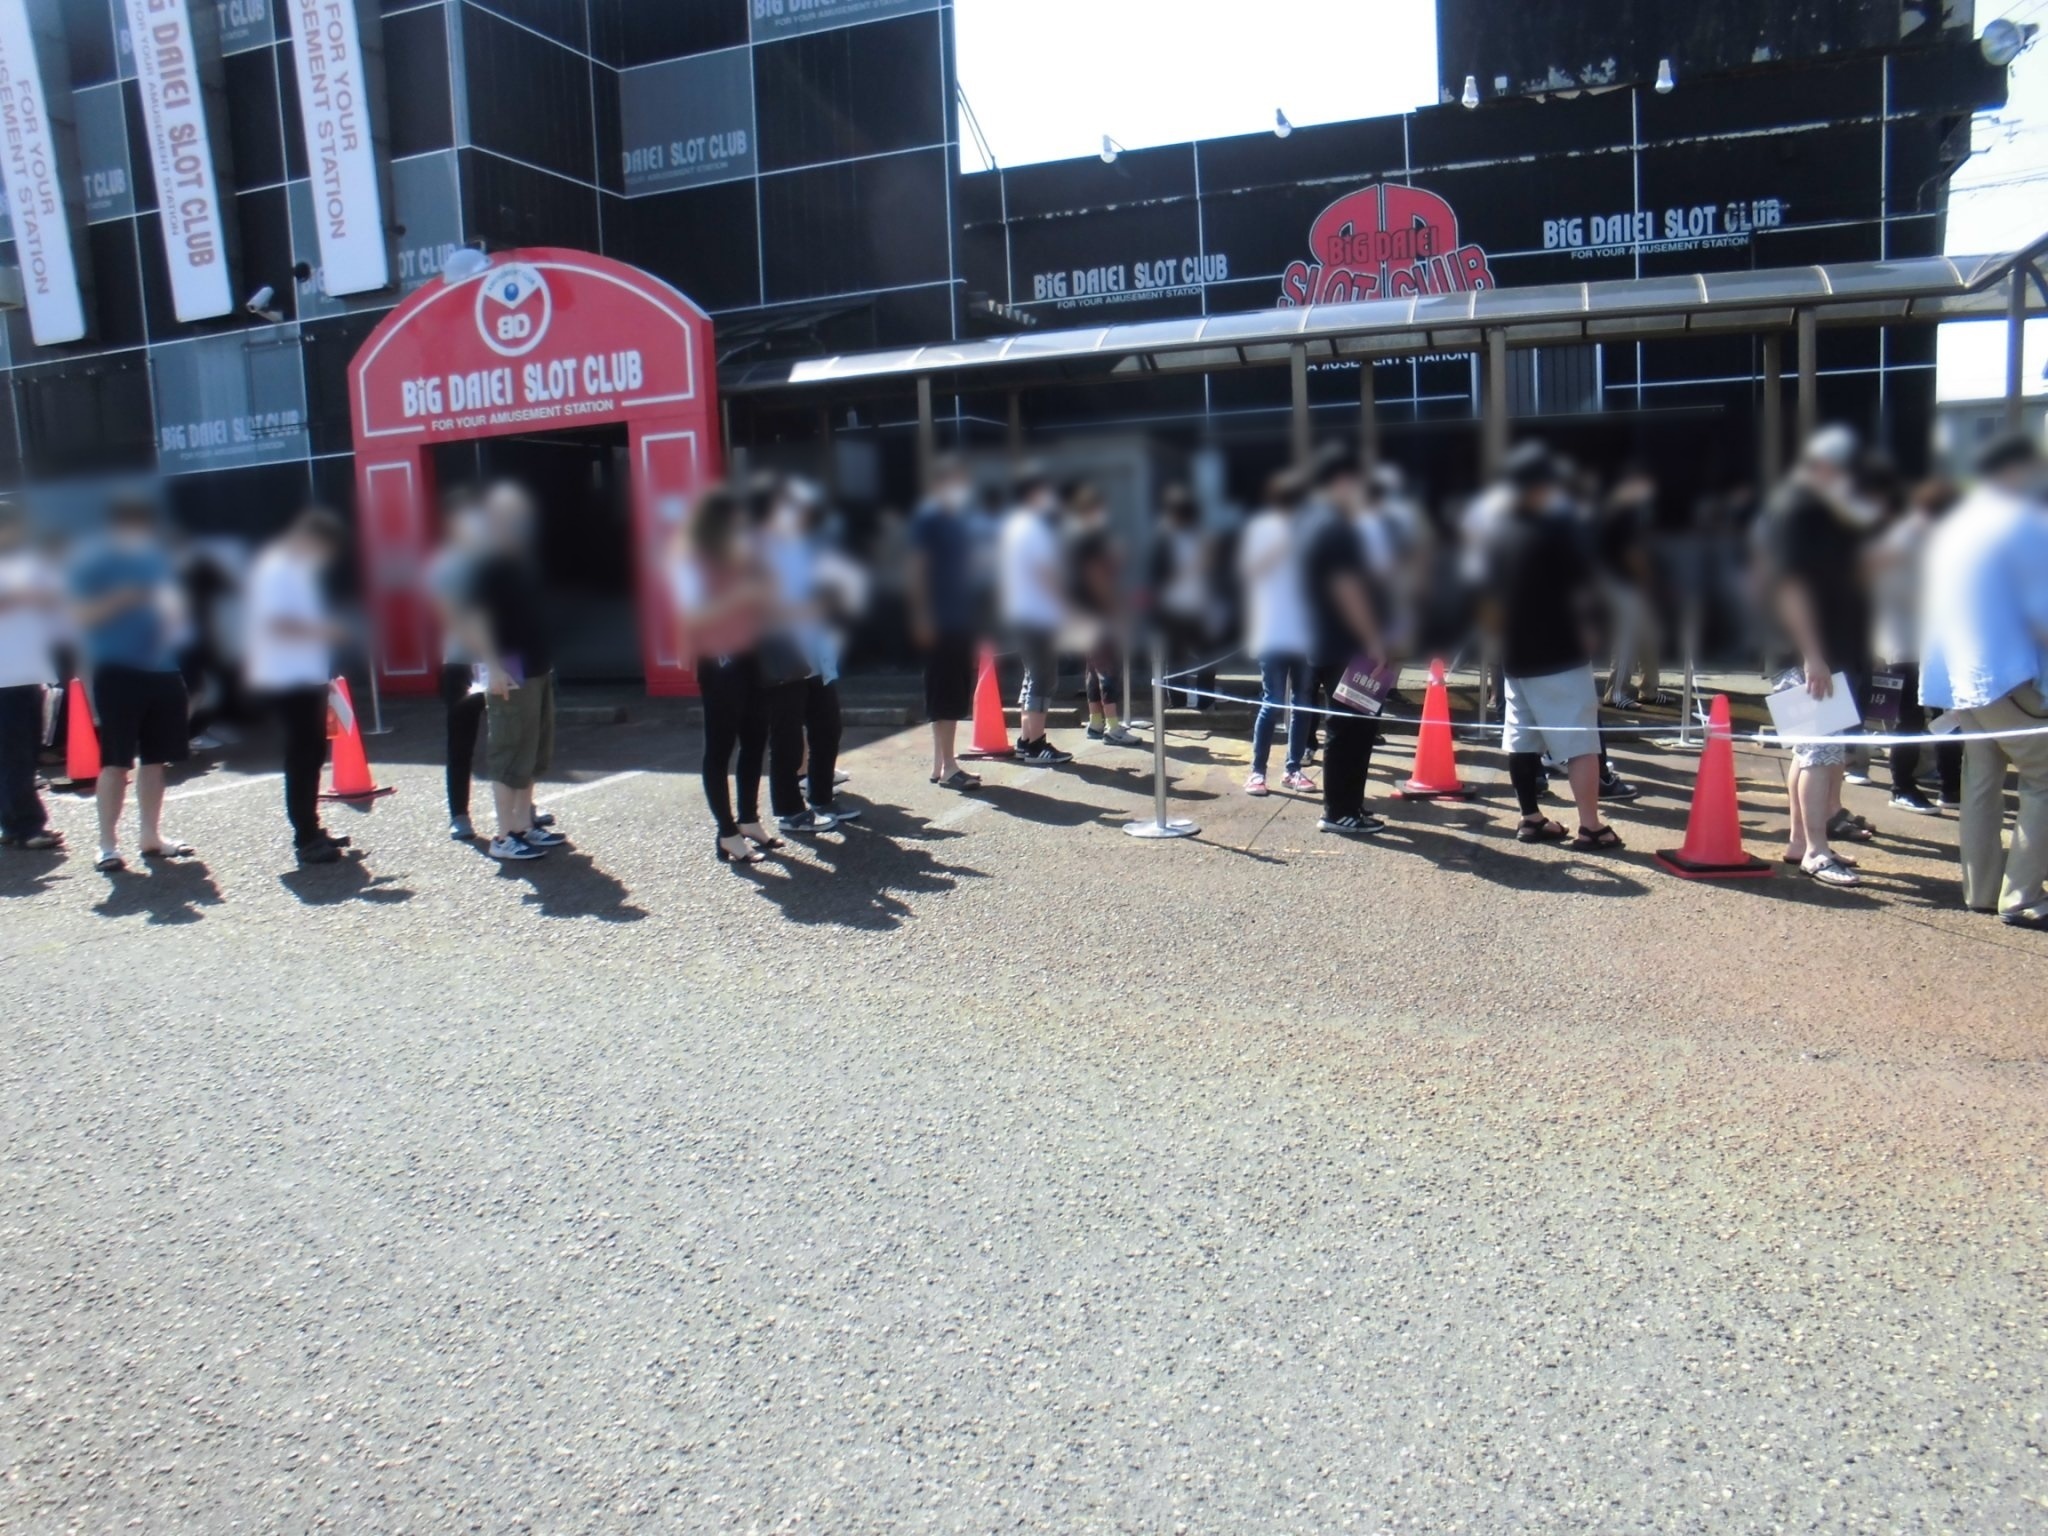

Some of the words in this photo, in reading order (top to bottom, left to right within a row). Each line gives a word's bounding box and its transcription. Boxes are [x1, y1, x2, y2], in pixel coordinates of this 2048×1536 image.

[324, 3, 347, 63] FOR
[152, 22, 192, 110] DAIEI
[333, 71, 358, 152] YOUR
[16, 79, 39, 134] FOR
[29, 143, 55, 216] YOUR
[168, 123, 203, 188] SLOT
[671, 137, 706, 166] SLOT
[709, 130, 747, 159] CLUB
[163, 176, 178, 236] STATION
[318, 120, 346, 239] STATION
[18, 188, 50, 294] STATION
[180, 197, 215, 268] CLUB
[1375, 225, 1440, 262] DAIEI
[1571, 250, 1593, 260] FOR
[1596, 247, 1625, 258] YOUR
[1628, 240, 1699, 255] AMUSEMENT
[1702, 236, 1749, 249] STATION
[1590, 212, 1653, 245] DAIEI
[1665, 206, 1716, 239] SLOT
[1724, 199, 1781, 232] CLUB
[1057, 300, 1076, 310] FOR
[1079, 297, 1103, 308] YOUR
[1105, 291, 1163, 304] AMUSEMENT
[1166, 286, 1204, 298] STATION
[1072, 265, 1125, 295] DAIEI
[1134, 259, 1177, 289] SLOT
[1181, 253, 1228, 284] CLUB
[449, 367, 513, 412] DAIEI
[524, 358, 577, 403] SLOT
[583, 350, 643, 396] CLUB
[432, 419, 454, 431] FOR
[456, 415, 486, 428] YOUR
[489, 405, 561, 424] AMUSEMENT
[564, 399, 614, 416] STATION
